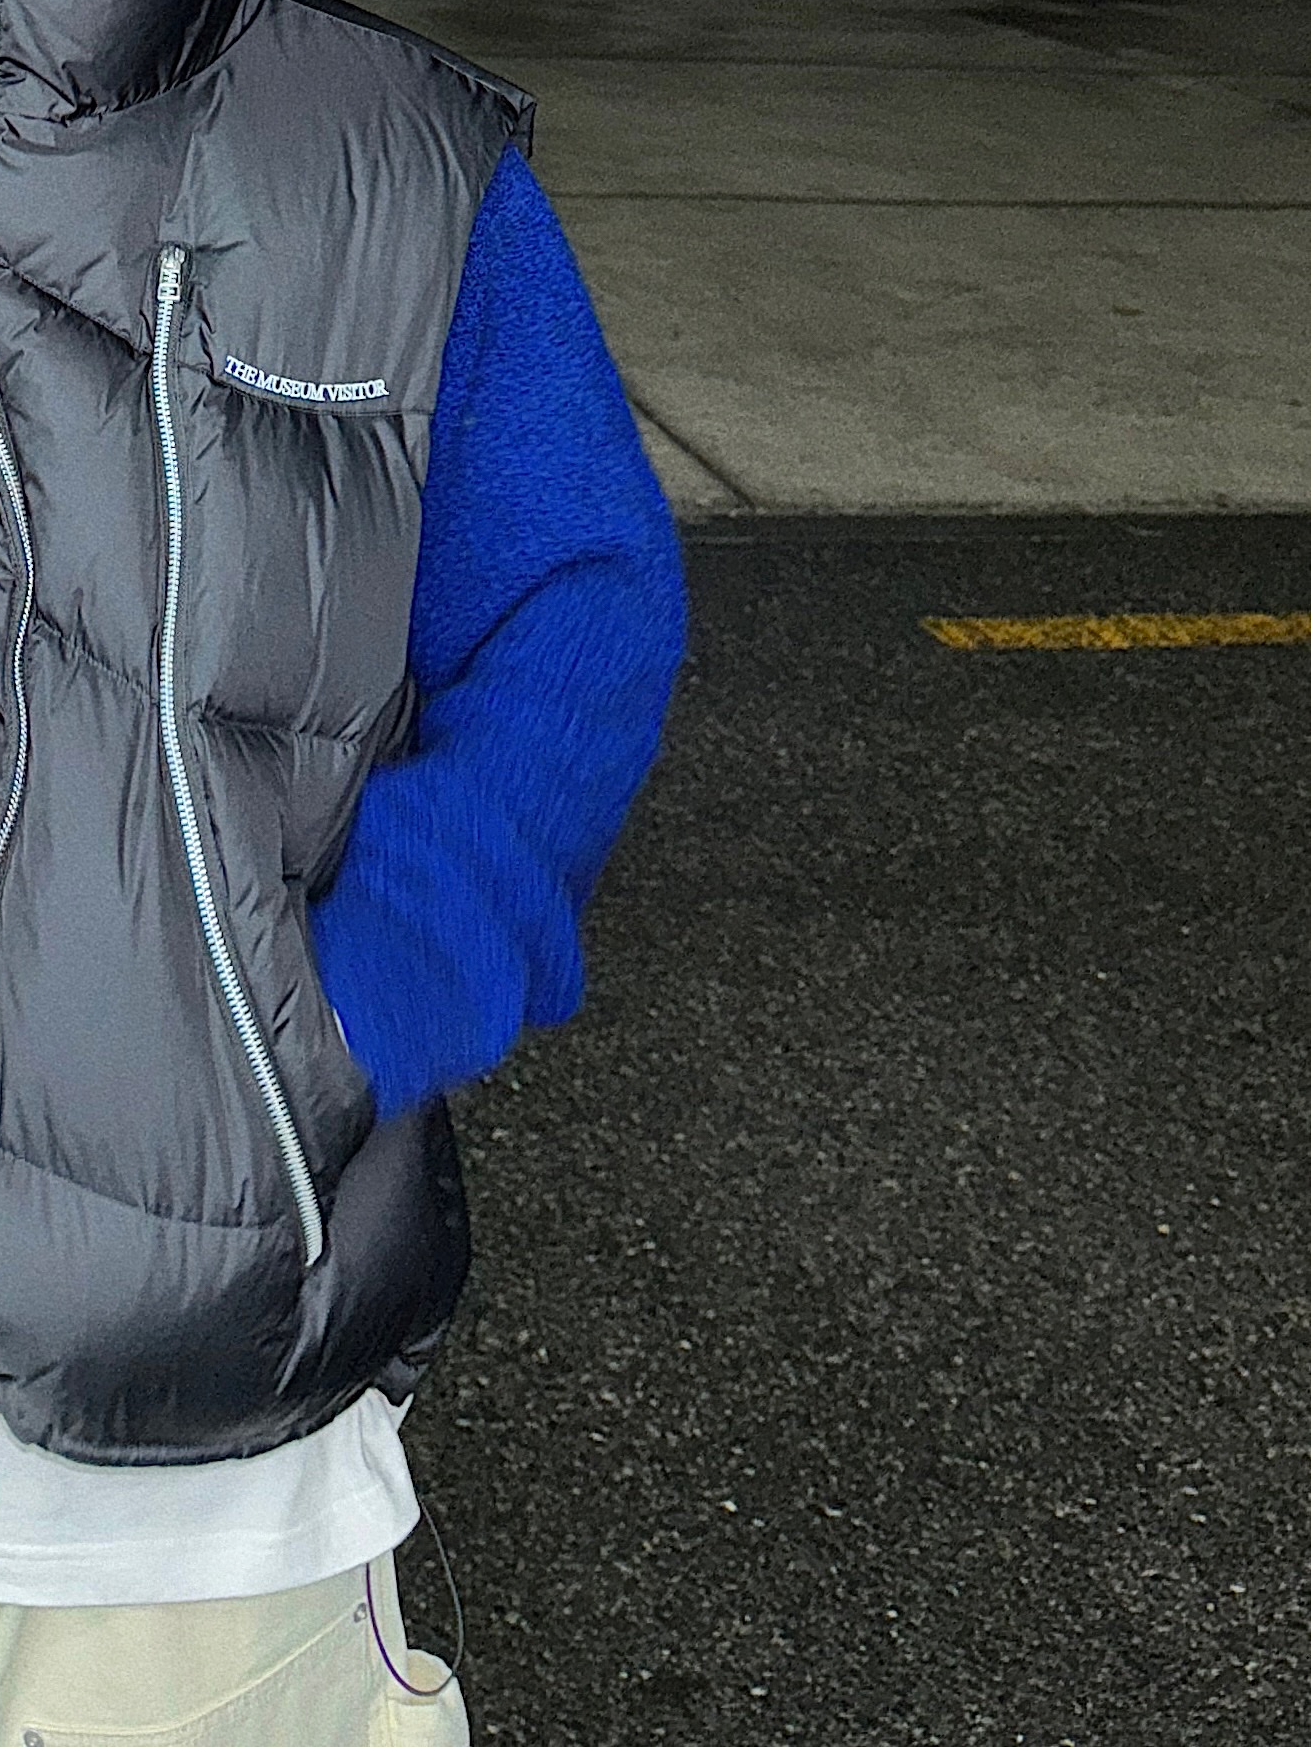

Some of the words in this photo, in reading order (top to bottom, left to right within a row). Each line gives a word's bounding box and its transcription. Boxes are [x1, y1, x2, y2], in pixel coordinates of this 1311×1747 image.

[224, 354, 258, 385] THE
[255, 369, 325, 402] MUSEUM
[324, 378, 390, 402] VISITOR
